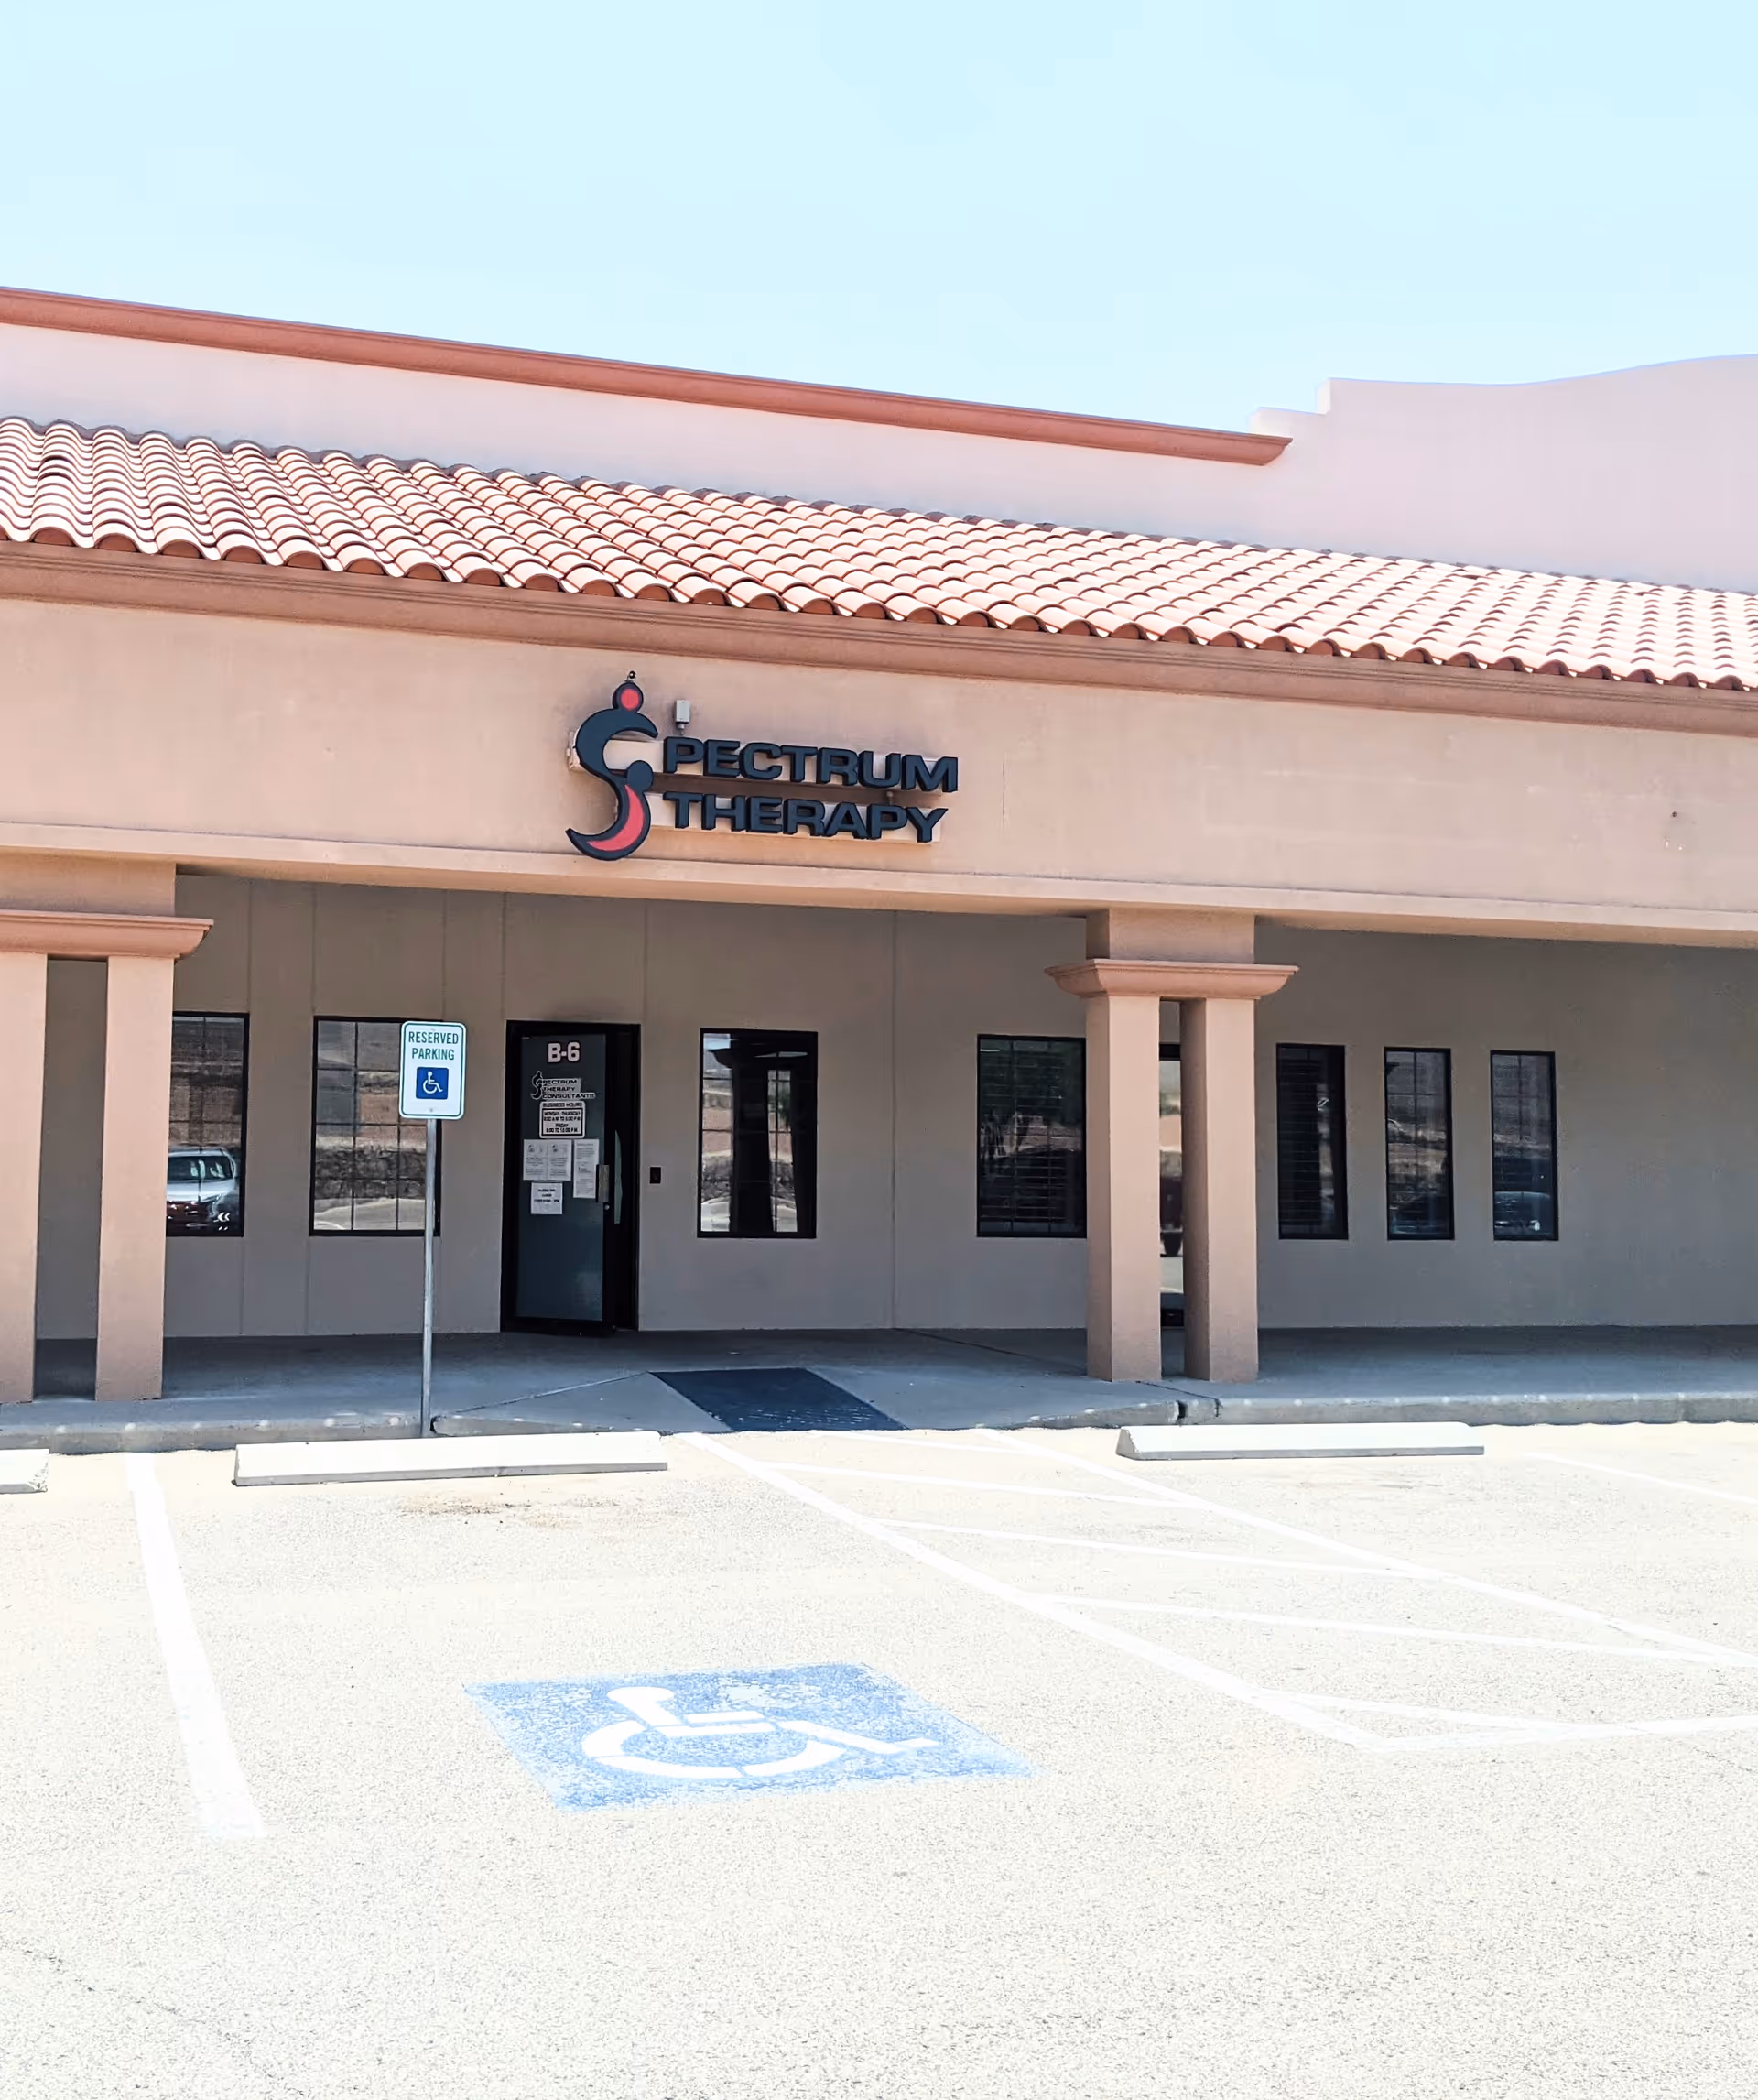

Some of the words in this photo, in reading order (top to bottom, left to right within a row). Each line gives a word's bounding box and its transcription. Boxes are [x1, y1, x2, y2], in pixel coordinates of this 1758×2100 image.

[662, 790, 949, 843] THERAPY
[408, 1031, 459, 1044] RESERVED
[411, 1047, 455, 1060] PARKING
[548, 1041, 580, 1063] B-6
